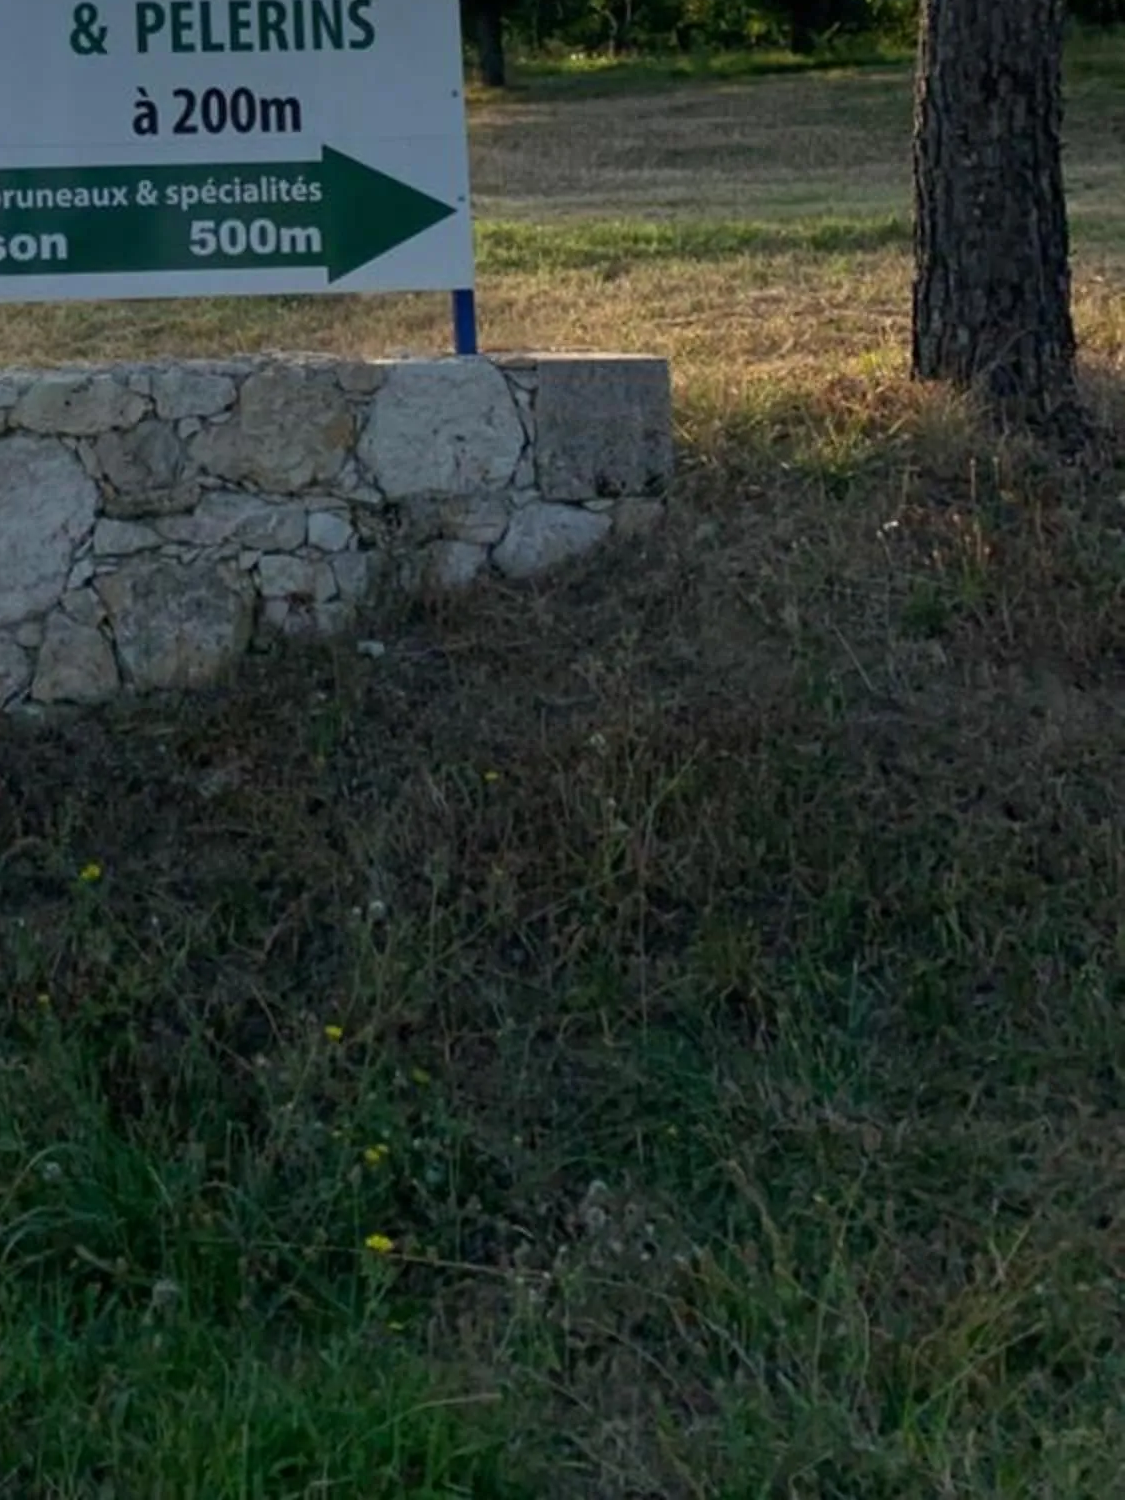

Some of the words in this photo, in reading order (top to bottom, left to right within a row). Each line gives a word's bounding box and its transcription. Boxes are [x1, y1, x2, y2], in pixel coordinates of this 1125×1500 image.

[70, 1, 108, 55] &
[132, 87, 158, 136] à
[172, 86, 302, 135] 200m
[136, 179, 158, 205] &
[165, 175, 323, 211] spécialités
[188, 217, 323, 256] 500m
